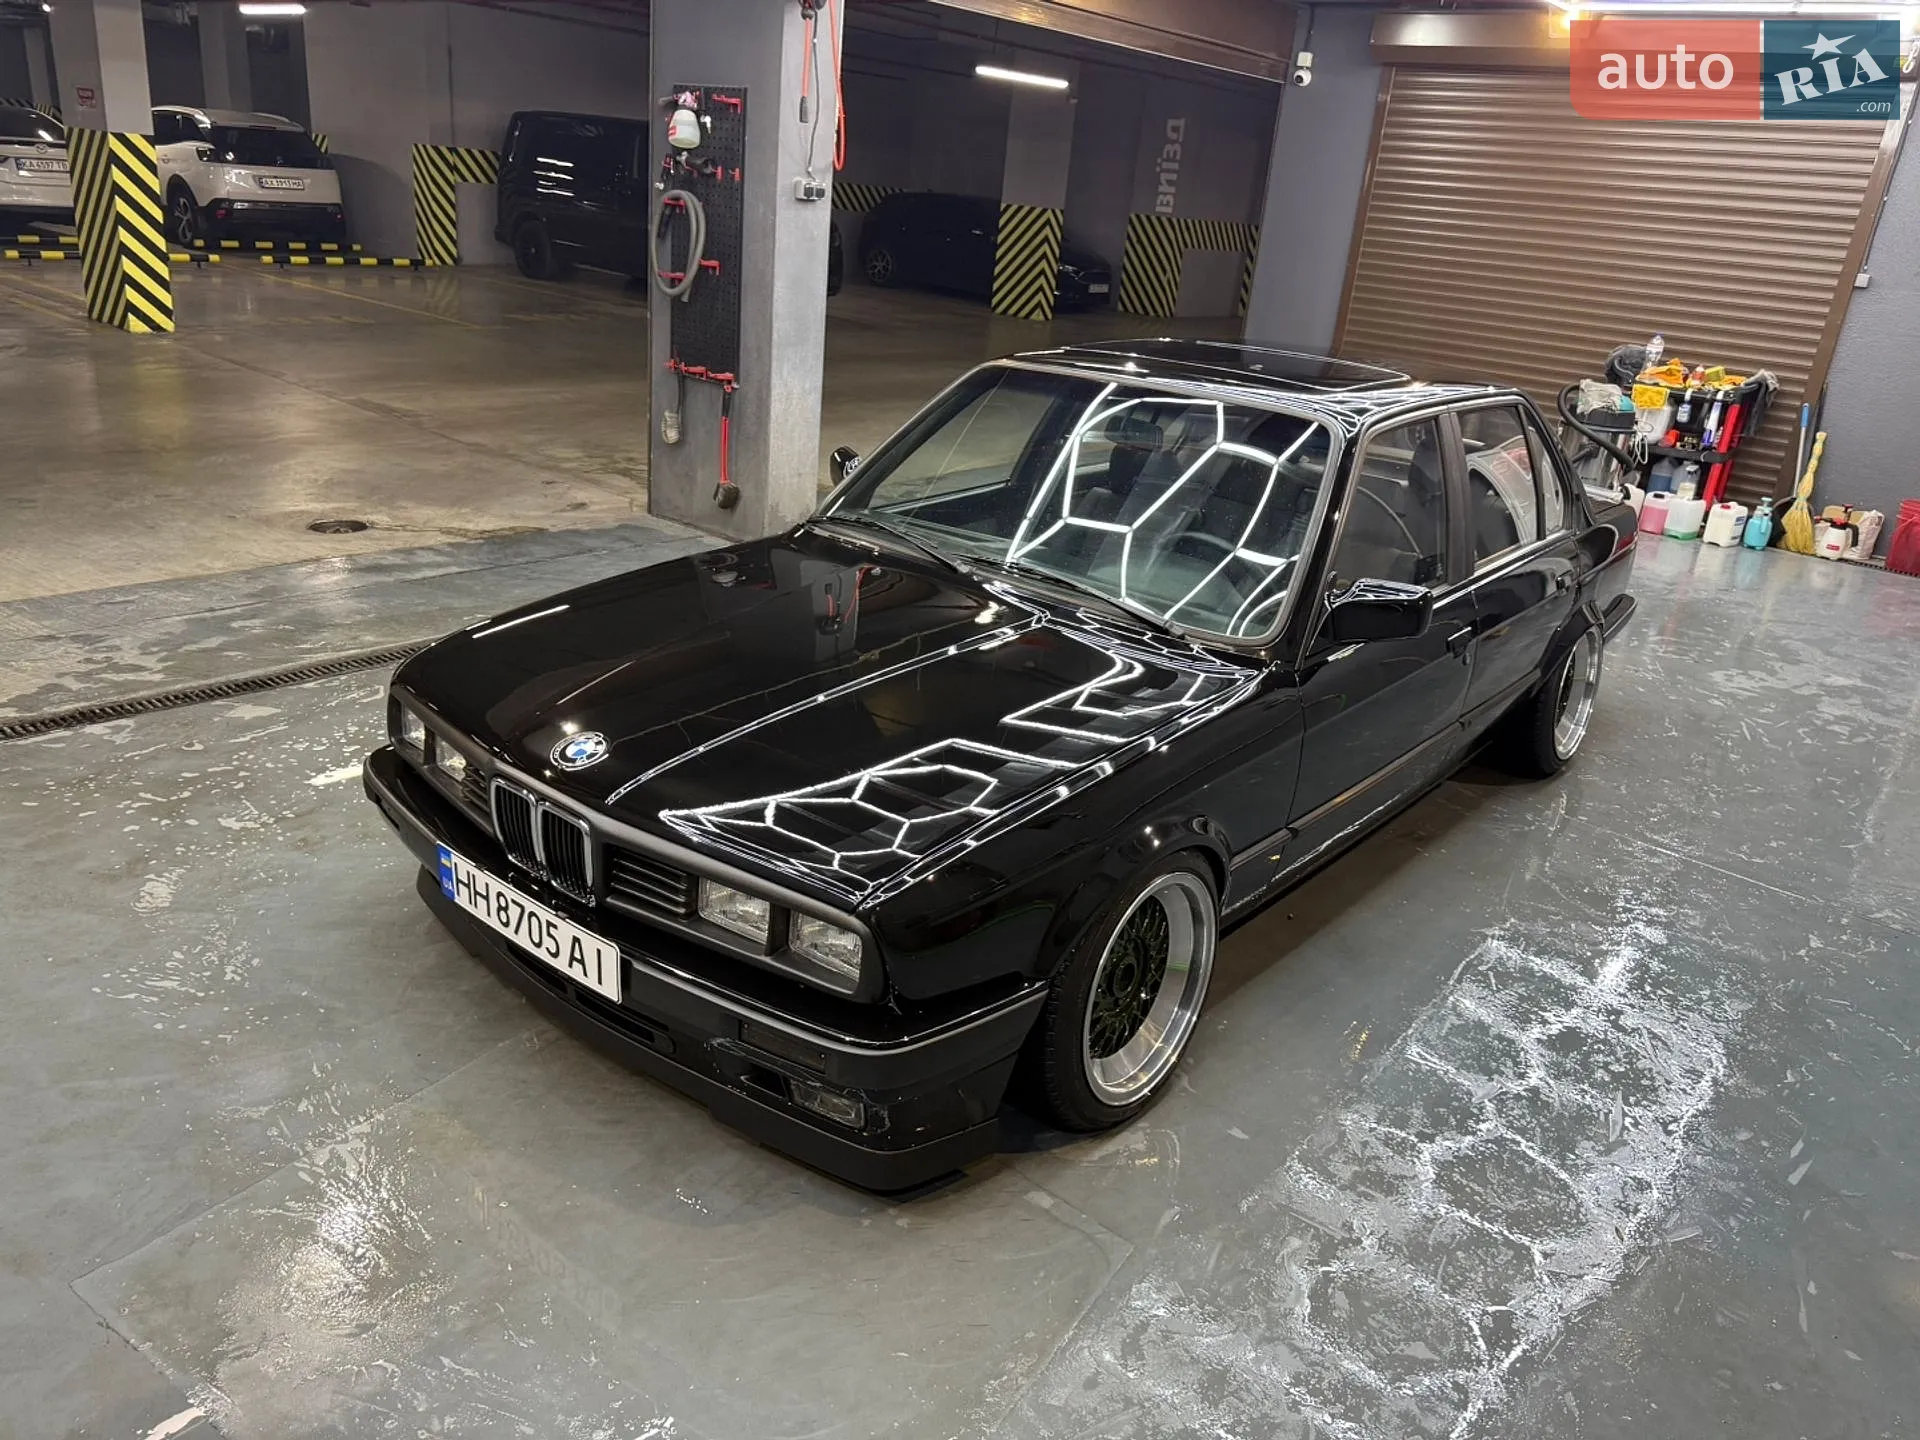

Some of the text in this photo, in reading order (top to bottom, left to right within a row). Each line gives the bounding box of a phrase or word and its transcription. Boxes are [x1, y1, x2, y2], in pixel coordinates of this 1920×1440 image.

[454, 861, 603, 986] HH 8705 AI
